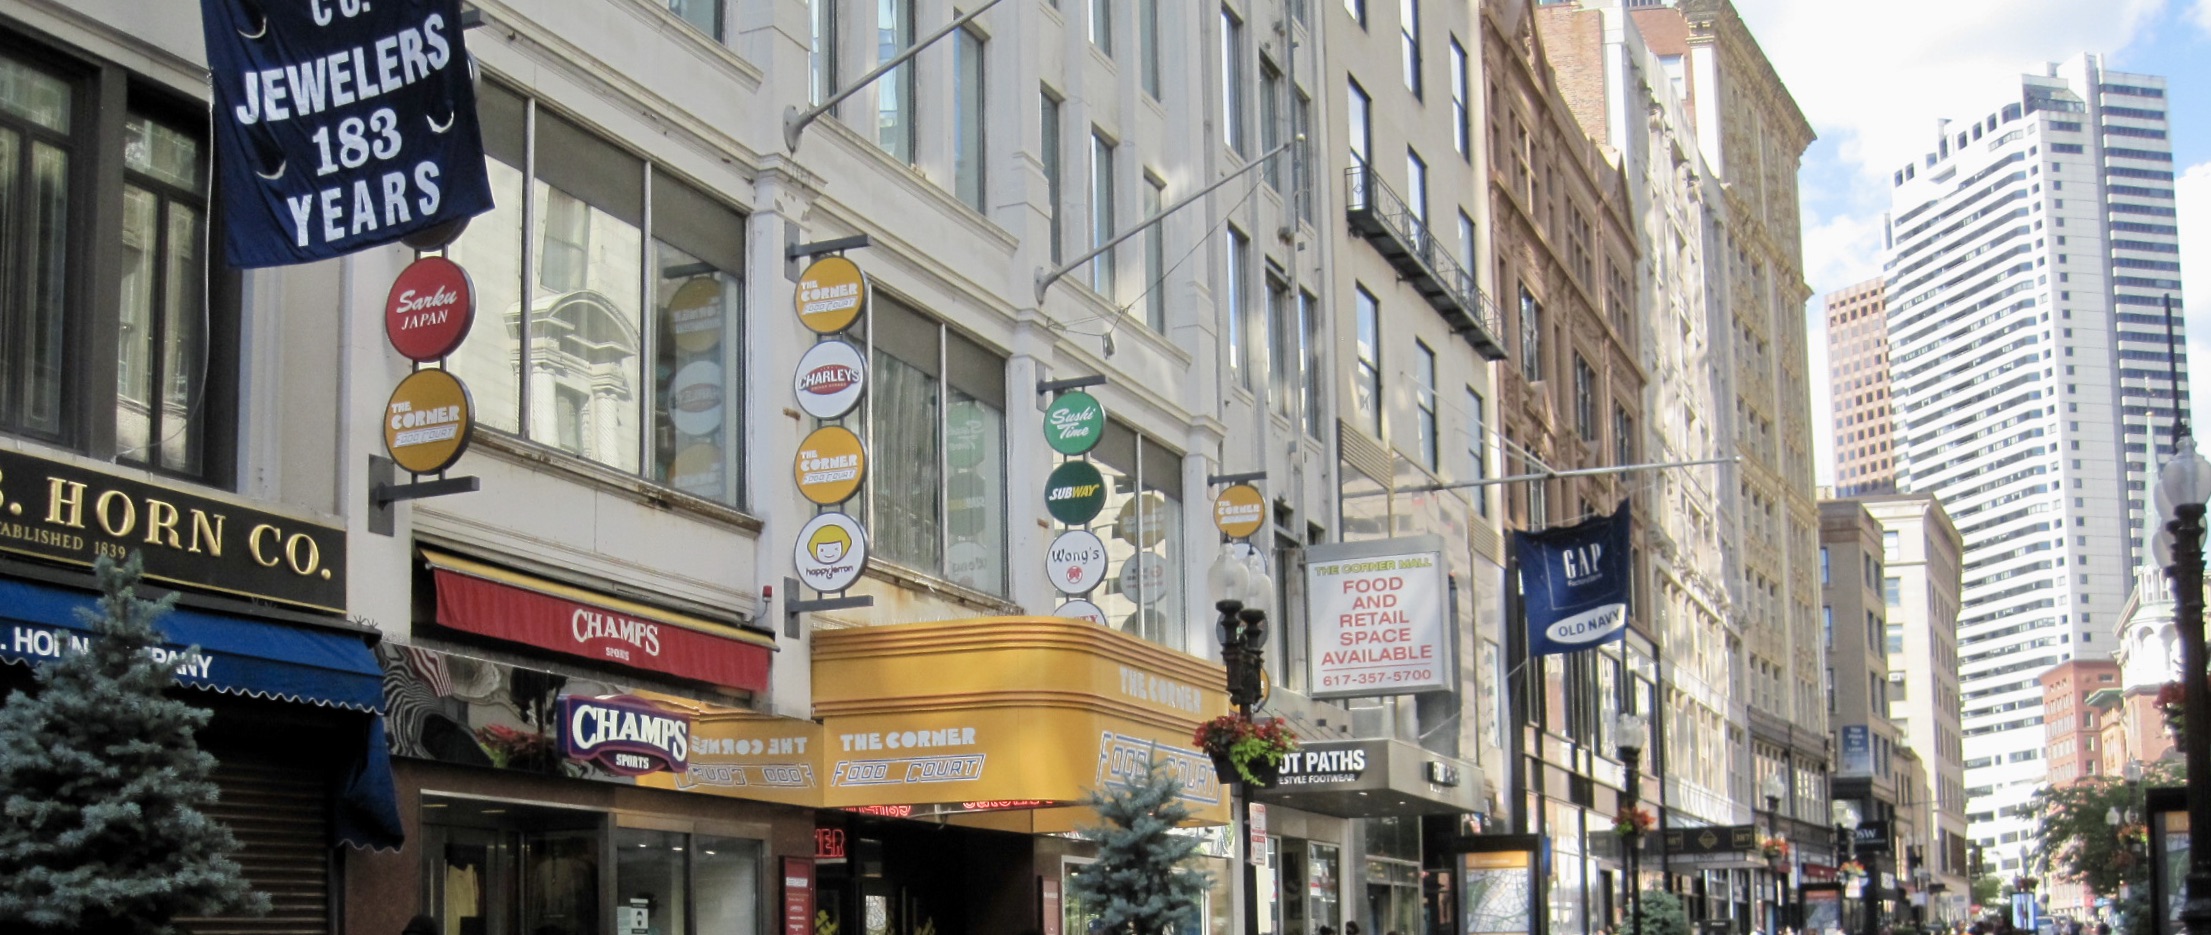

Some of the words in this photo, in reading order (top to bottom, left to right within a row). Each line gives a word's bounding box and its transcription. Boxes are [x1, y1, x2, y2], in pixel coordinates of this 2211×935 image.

[236, 13, 450, 125] JEWELERS
[312, 107, 402, 176] 183
[287, 160, 441, 247] YEARS
[801, 280, 817, 290] THE
[801, 282, 858, 302] CORNER
[396, 285, 457, 314] Sarku
[401, 309, 449, 331] JAPAN
[799, 369, 860, 390] CHARLEYS
[391, 401, 412, 414] THE
[391, 405, 460, 430] CORNER
[1050, 406, 1096, 425] Sushi
[1057, 421, 1089, 439] Time
[800, 450, 817, 459] THE
[800, 454, 858, 471] CORNER
[1049, 484, 1099, 500] SUBWAY
[44, 476, 226, 557] HORN
[249, 524, 332, 580] CO.
[0, 521, 84, 551] ABLISHED
[94, 541, 126, 560] 1839
[1052, 547, 1099, 564] Wong's
[1563, 543, 1601, 579] GAP
[1315, 565, 1339, 576] THE
[1342, 560, 1395, 574] CORNER
[1399, 558, 1432, 569] MALL
[1343, 577, 1403, 594] FOOD
[1352, 594, 1397, 610] AND
[1340, 610, 1410, 628] RETAIL
[1558, 623, 1585, 637] OLD
[1588, 609, 1619, 631] NAVY
[572, 608, 659, 656] CHAMPS
[1340, 628, 1411, 646] SPACE
[1322, 645, 1433, 665] AVAILABLE
[1323, 669, 1432, 686] 617-357-5700
[1120, 666, 1147, 700] THE
[1150, 676, 1201, 713] CORNER
[572, 704, 687, 762] CHAMPS
[840, 734, 882, 751] THE
[886, 727, 976, 749] CORNER
[616, 753, 649, 769] SPORTS
[1306, 749, 1365, 773] PATHS
[831, 761, 887, 786] FOOD
[905, 757, 977, 783] COURT
[1278, 776, 1307, 785] ESTYLE
[1308, 773, 1355, 783] FOOTWEAR
